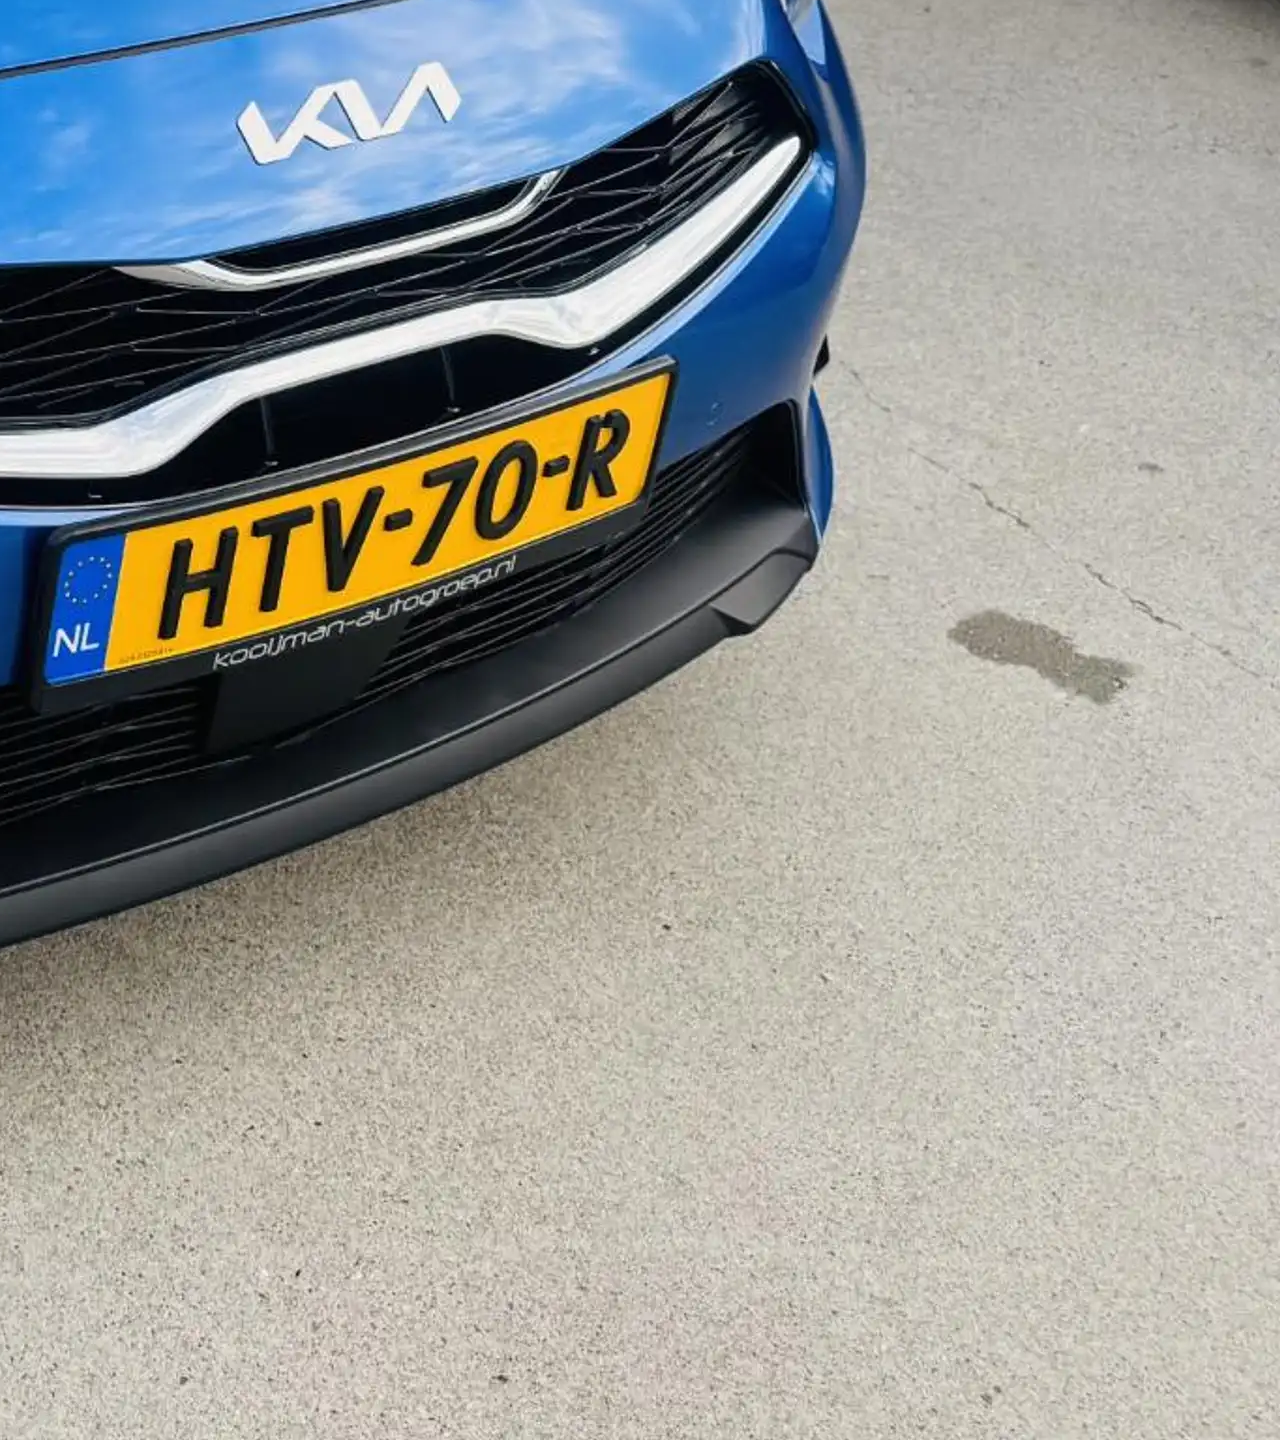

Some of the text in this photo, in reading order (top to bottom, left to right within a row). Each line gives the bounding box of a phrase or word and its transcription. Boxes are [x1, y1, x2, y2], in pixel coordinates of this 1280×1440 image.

[236, 61, 462, 165] KIA
[158, 408, 631, 640] HTV-70-R
[52, 622, 100, 657] NL
